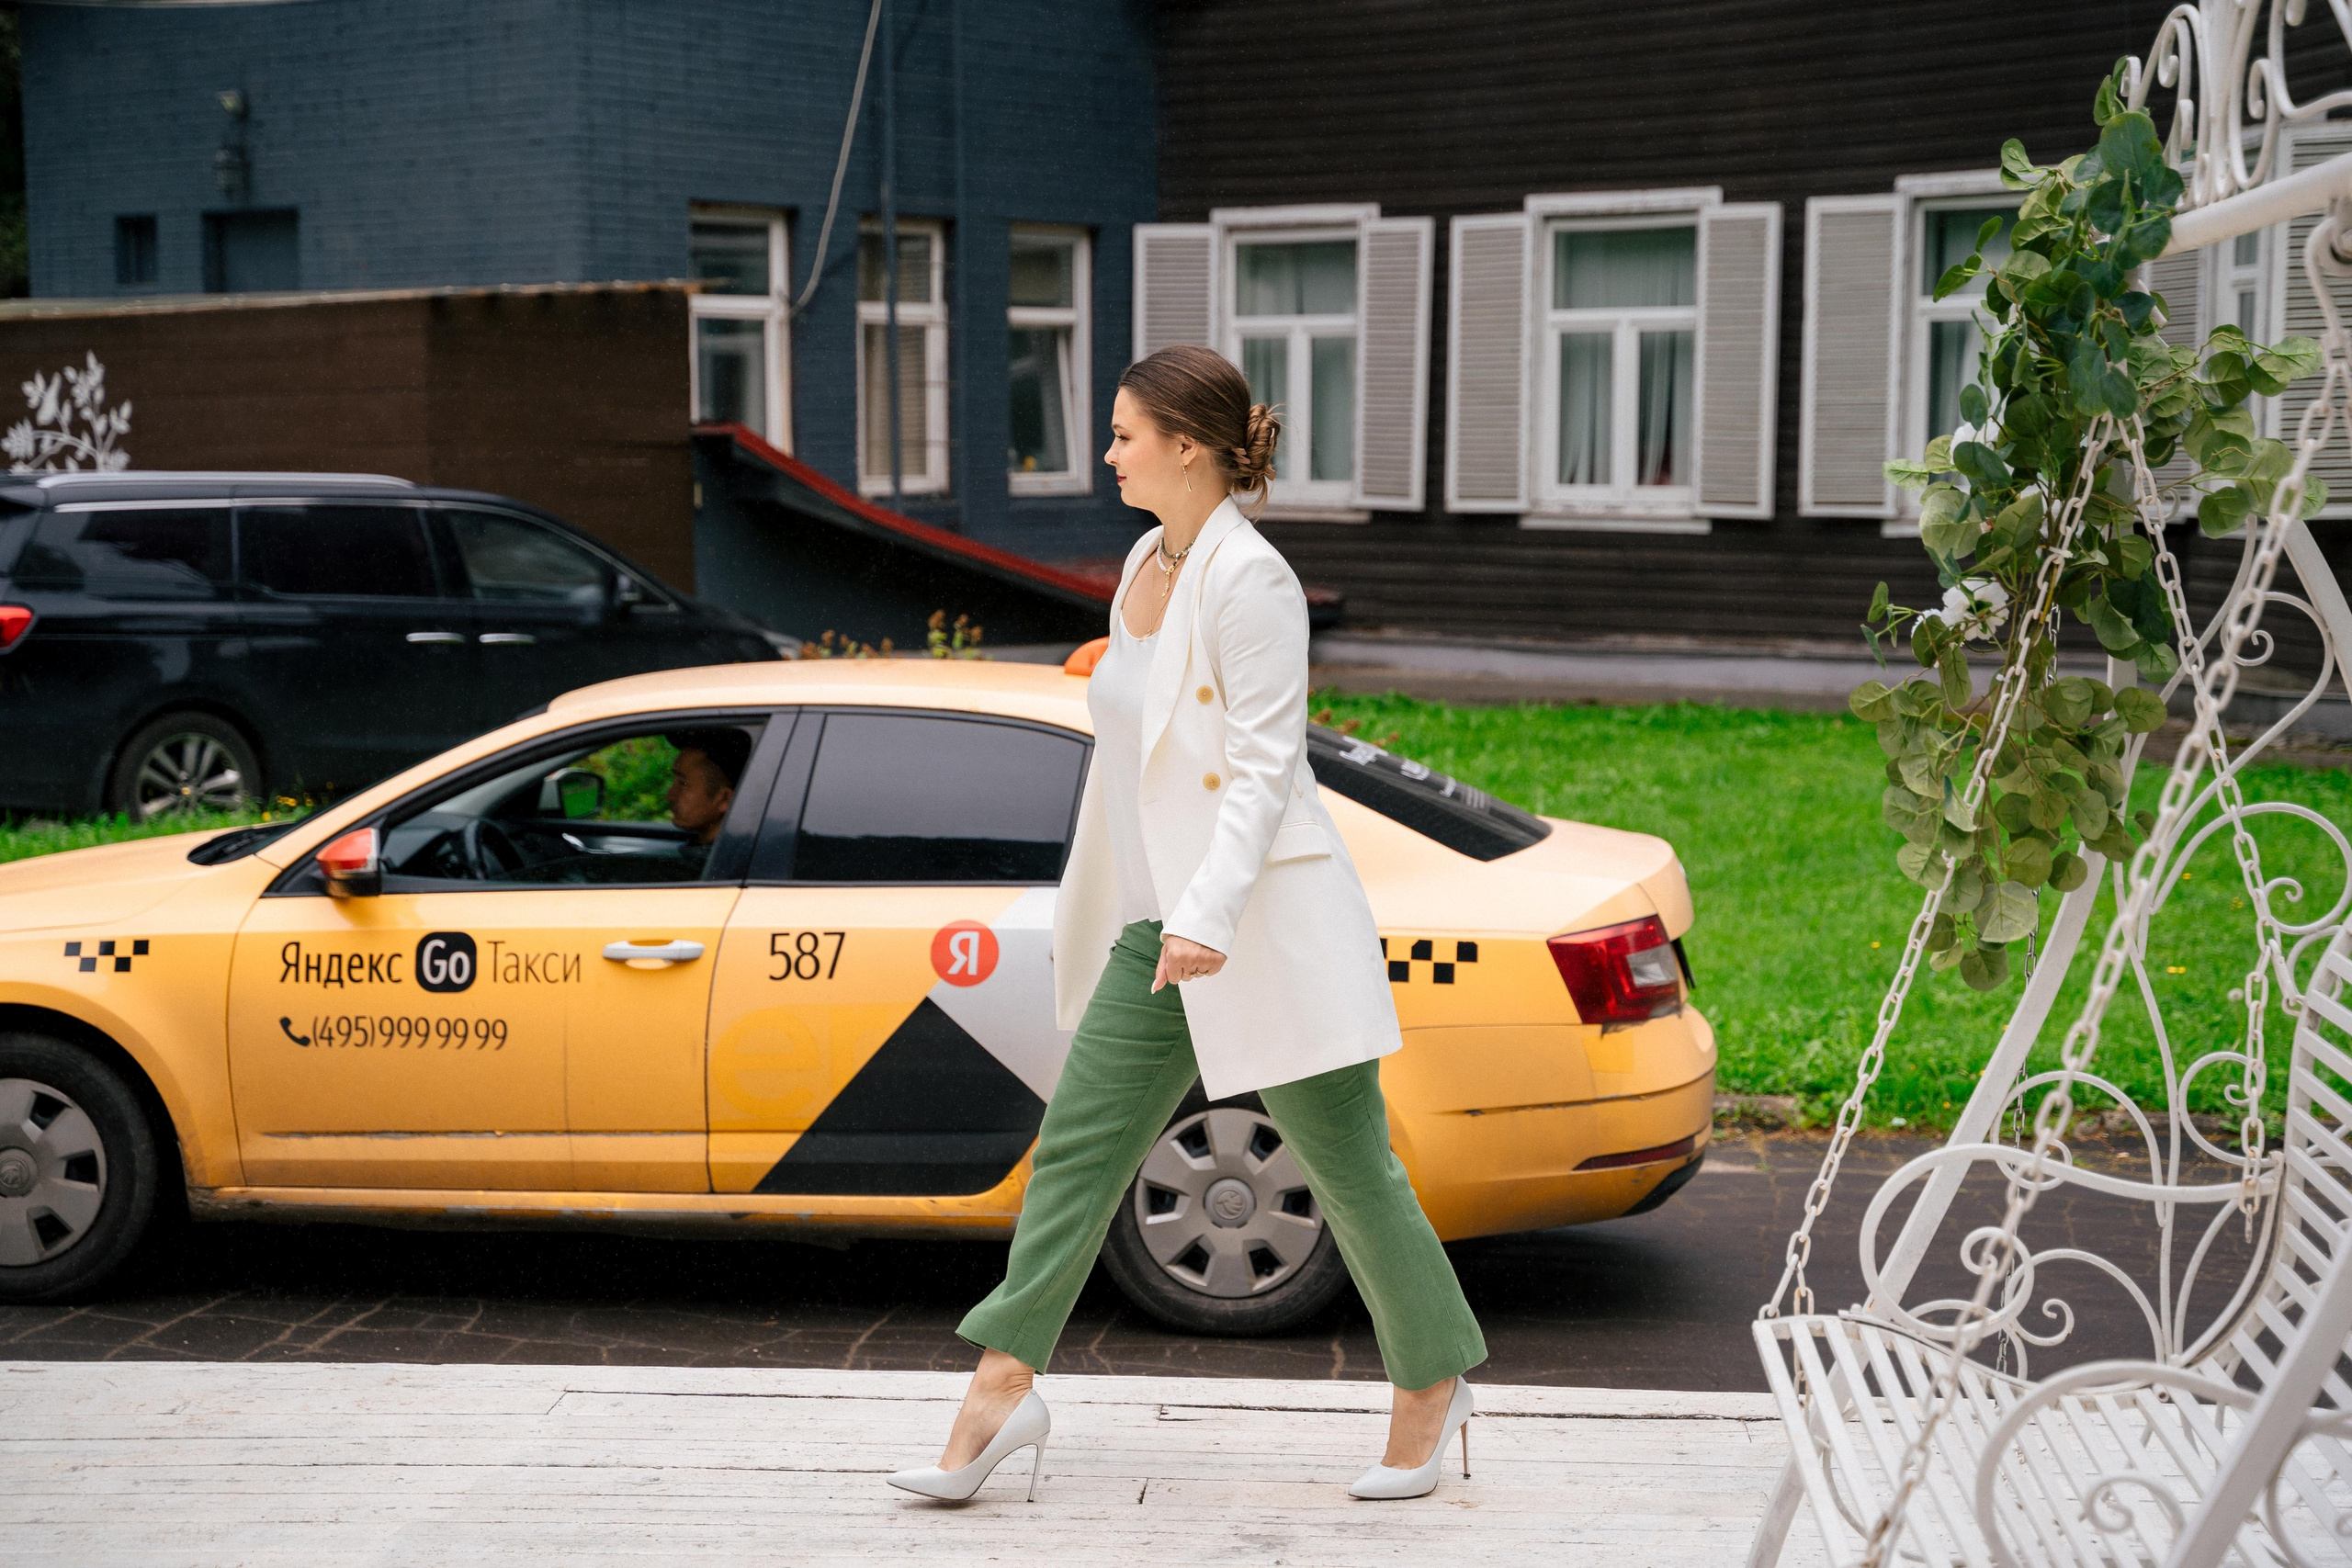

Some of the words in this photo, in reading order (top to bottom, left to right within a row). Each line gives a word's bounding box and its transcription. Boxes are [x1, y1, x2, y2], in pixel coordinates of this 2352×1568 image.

[279, 942, 402, 989] Яндекс
[422, 938, 471, 985] Go
[486, 940, 582, 984] Такси
[768, 931, 846, 981] 587
[947, 931, 980, 976] Я
